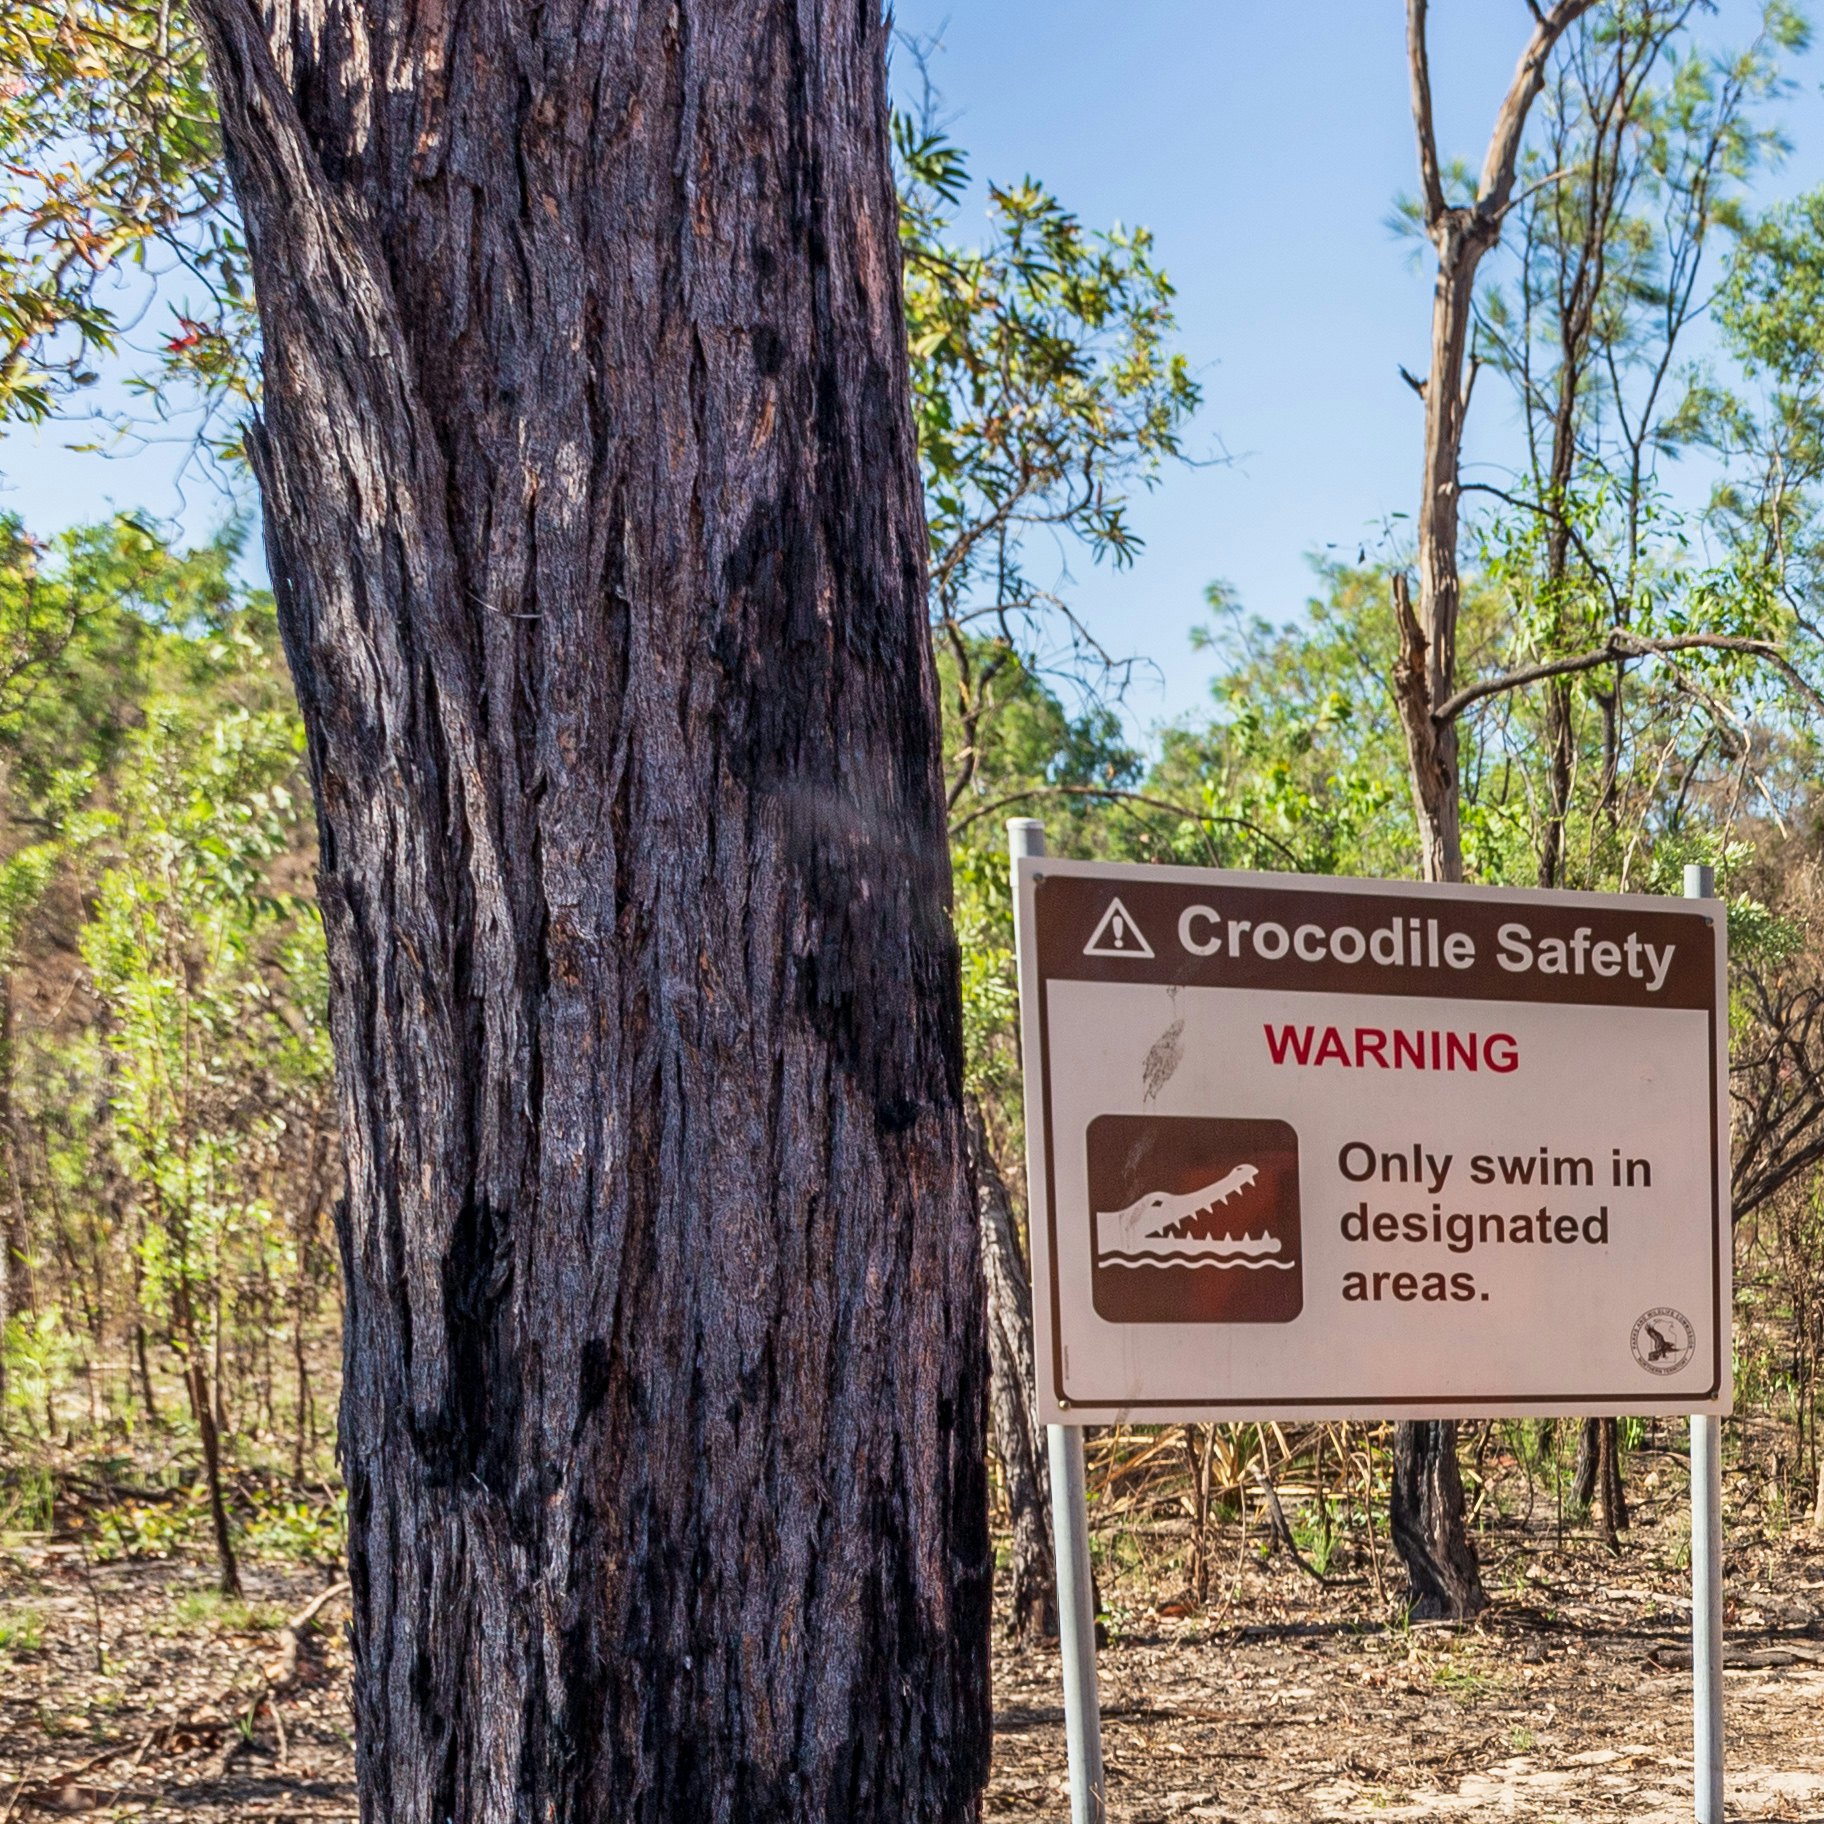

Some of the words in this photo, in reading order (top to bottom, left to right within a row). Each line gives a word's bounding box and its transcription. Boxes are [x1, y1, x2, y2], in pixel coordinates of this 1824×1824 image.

[1177, 904, 1477, 970] Crocodile
[1496, 923, 1676, 992] Safety
[1264, 1023, 1519, 1074] WARNING
[1338, 1142, 1453, 1193] Only
[1469, 1146, 1595, 1187] swim
[1611, 1148, 1653, 1188] in
[1340, 1202, 1609, 1253] designated
[1341, 1268, 1491, 1302] areas.
